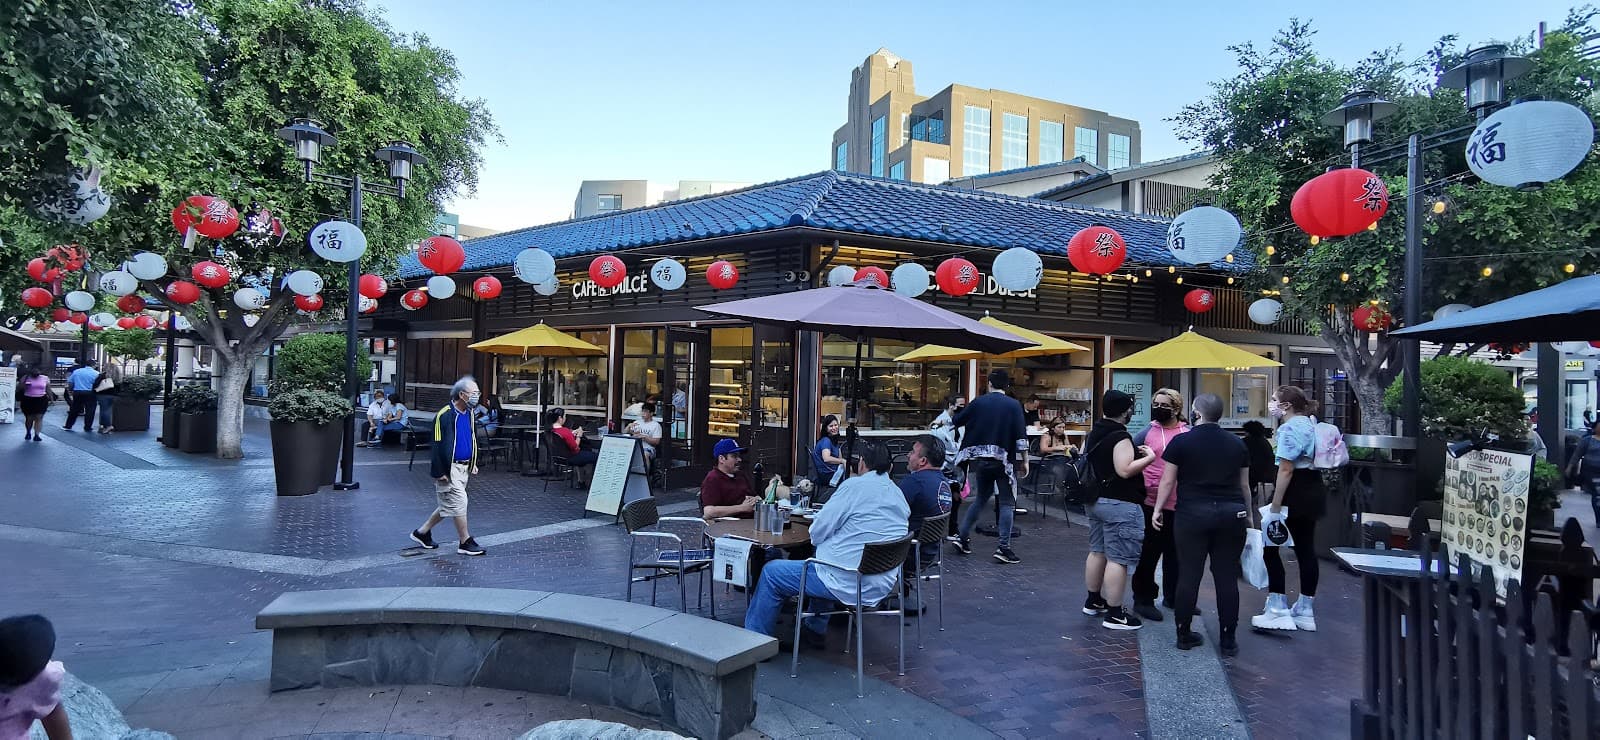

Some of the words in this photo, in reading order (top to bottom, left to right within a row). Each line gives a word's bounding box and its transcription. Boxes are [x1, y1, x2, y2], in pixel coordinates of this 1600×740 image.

[1467, 121, 1506, 170] 福
[1354, 176, 1389, 212] 祭
[203, 200, 235, 225] 祭
[317, 228, 343, 250] 福
[1090, 232, 1120, 257] 祭
[600, 261, 619, 278] 祭
[655, 265, 672, 282] 福
[954, 264, 977, 285] 祭
[1479, 451, 1513, 468] SPECIAL
